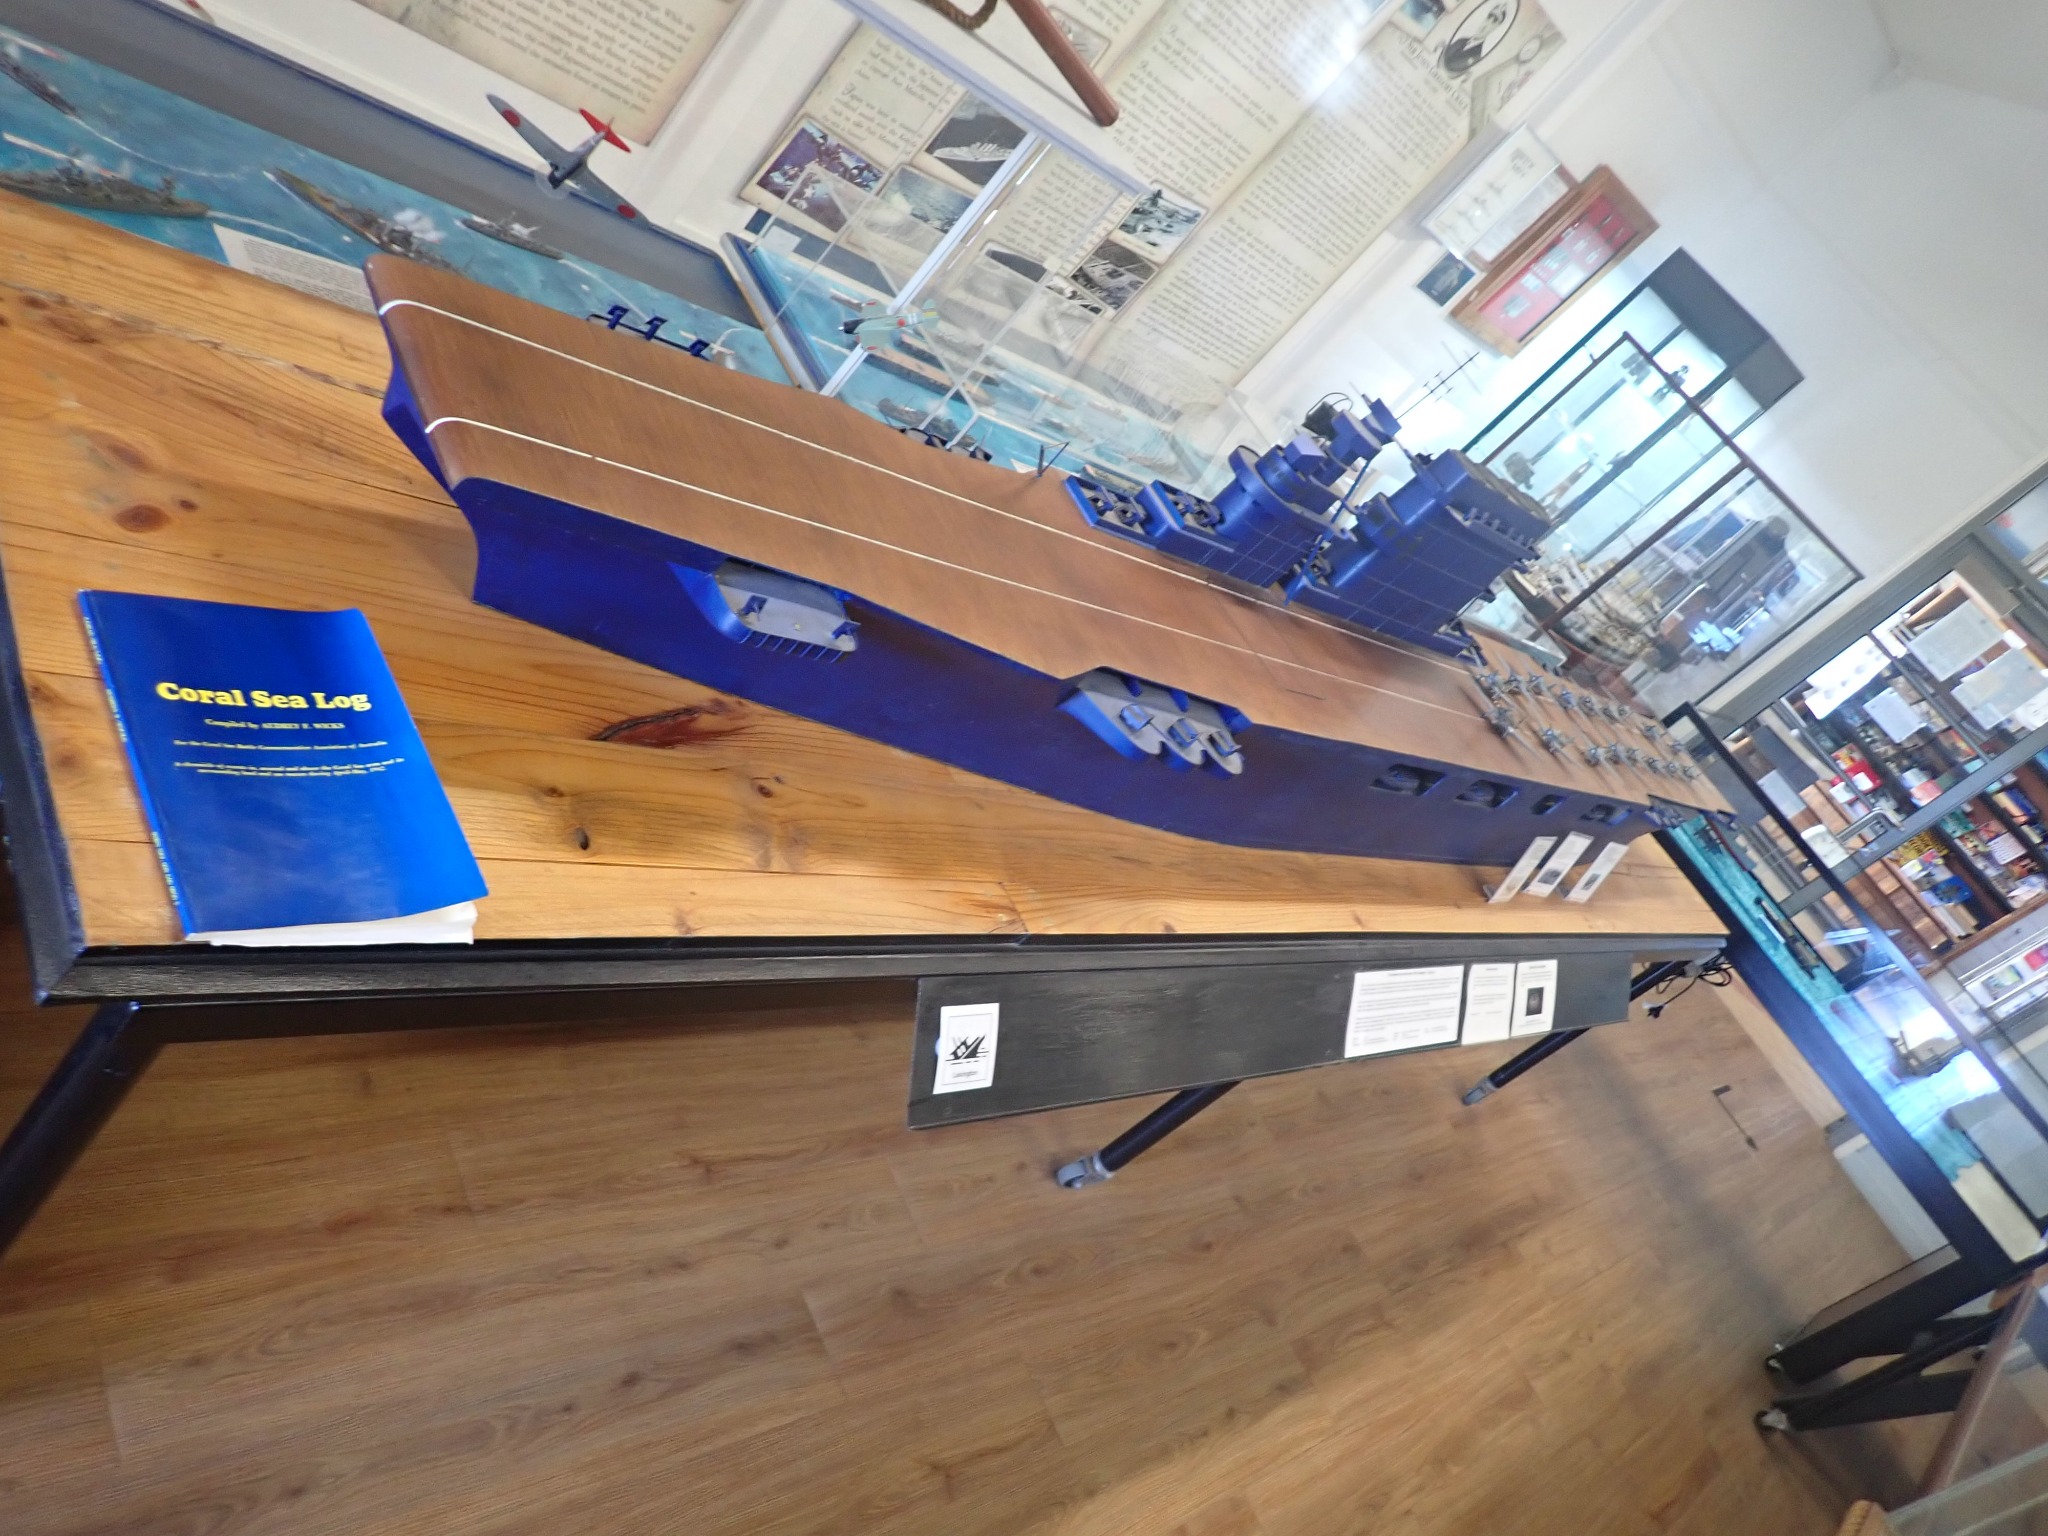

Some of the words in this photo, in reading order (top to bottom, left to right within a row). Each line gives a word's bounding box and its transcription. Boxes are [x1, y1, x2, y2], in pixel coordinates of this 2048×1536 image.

[156, 682, 248, 706] Coral
[251, 690, 309, 708] Sea
[312, 692, 372, 711] Log
